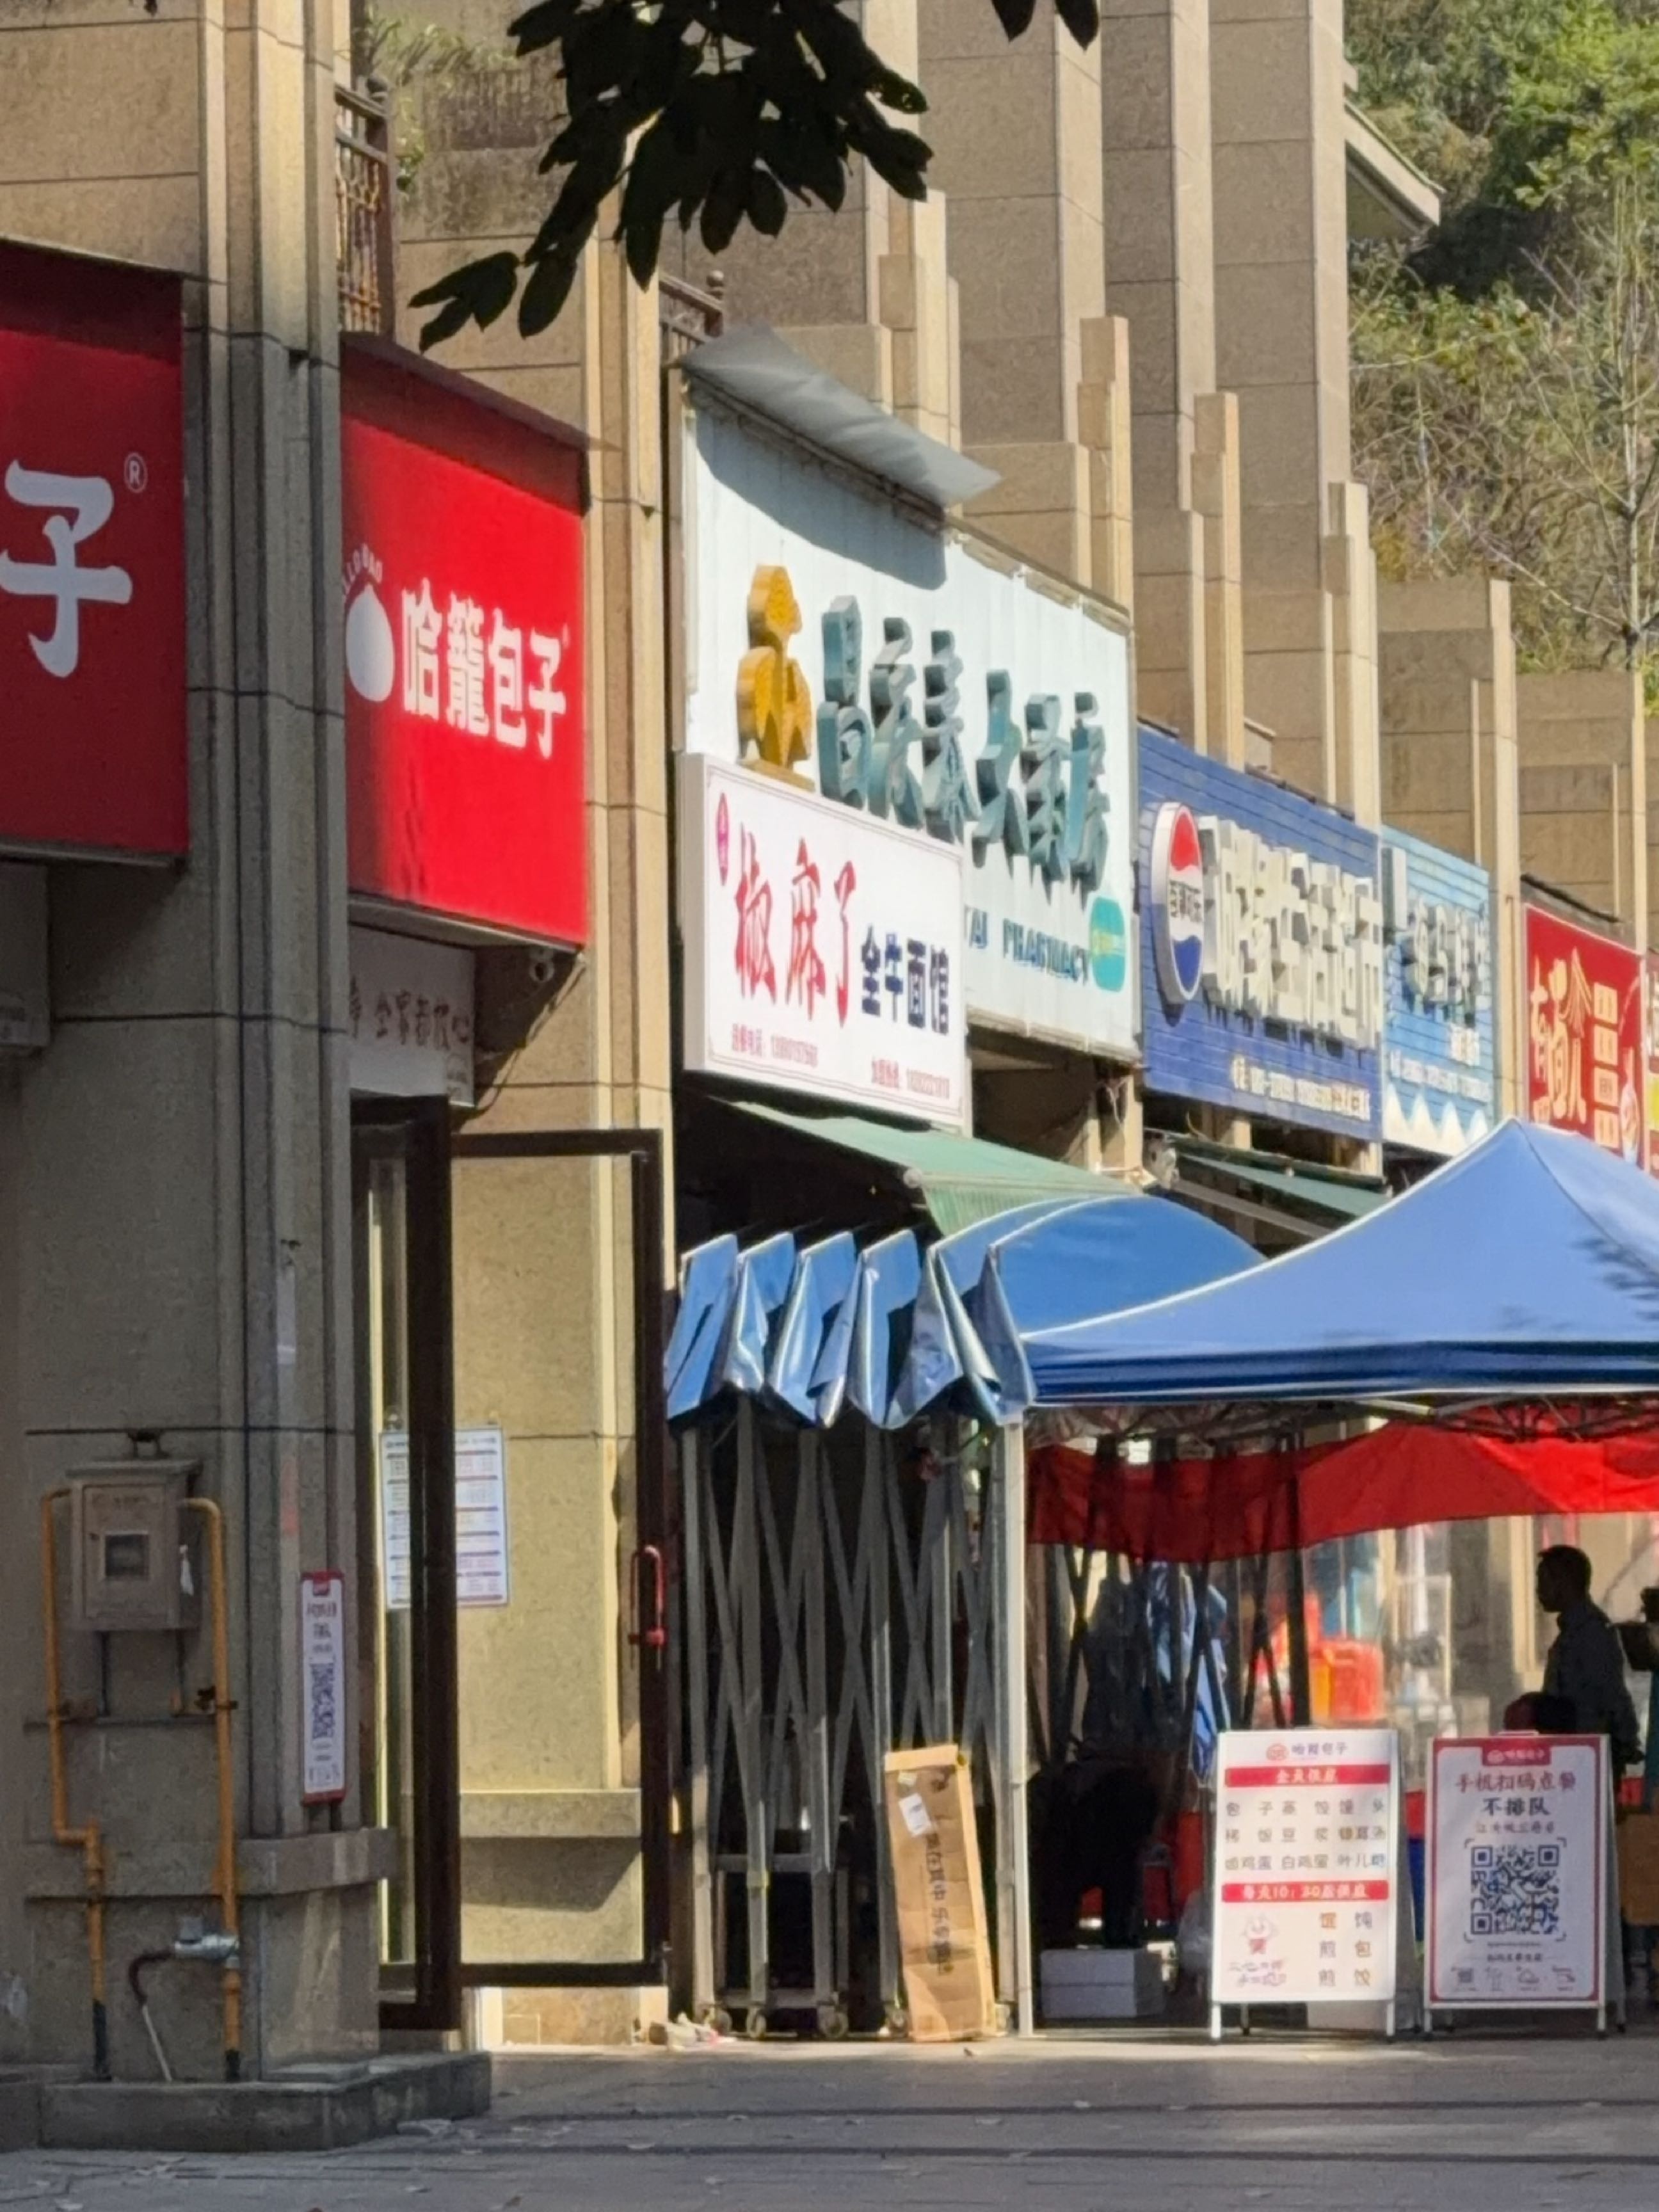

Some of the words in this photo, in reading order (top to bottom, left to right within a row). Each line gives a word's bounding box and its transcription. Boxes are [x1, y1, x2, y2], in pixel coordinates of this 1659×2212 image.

[0, 460, 132, 678] 子
[1480, 1797, 1551, 1816] 不排队
